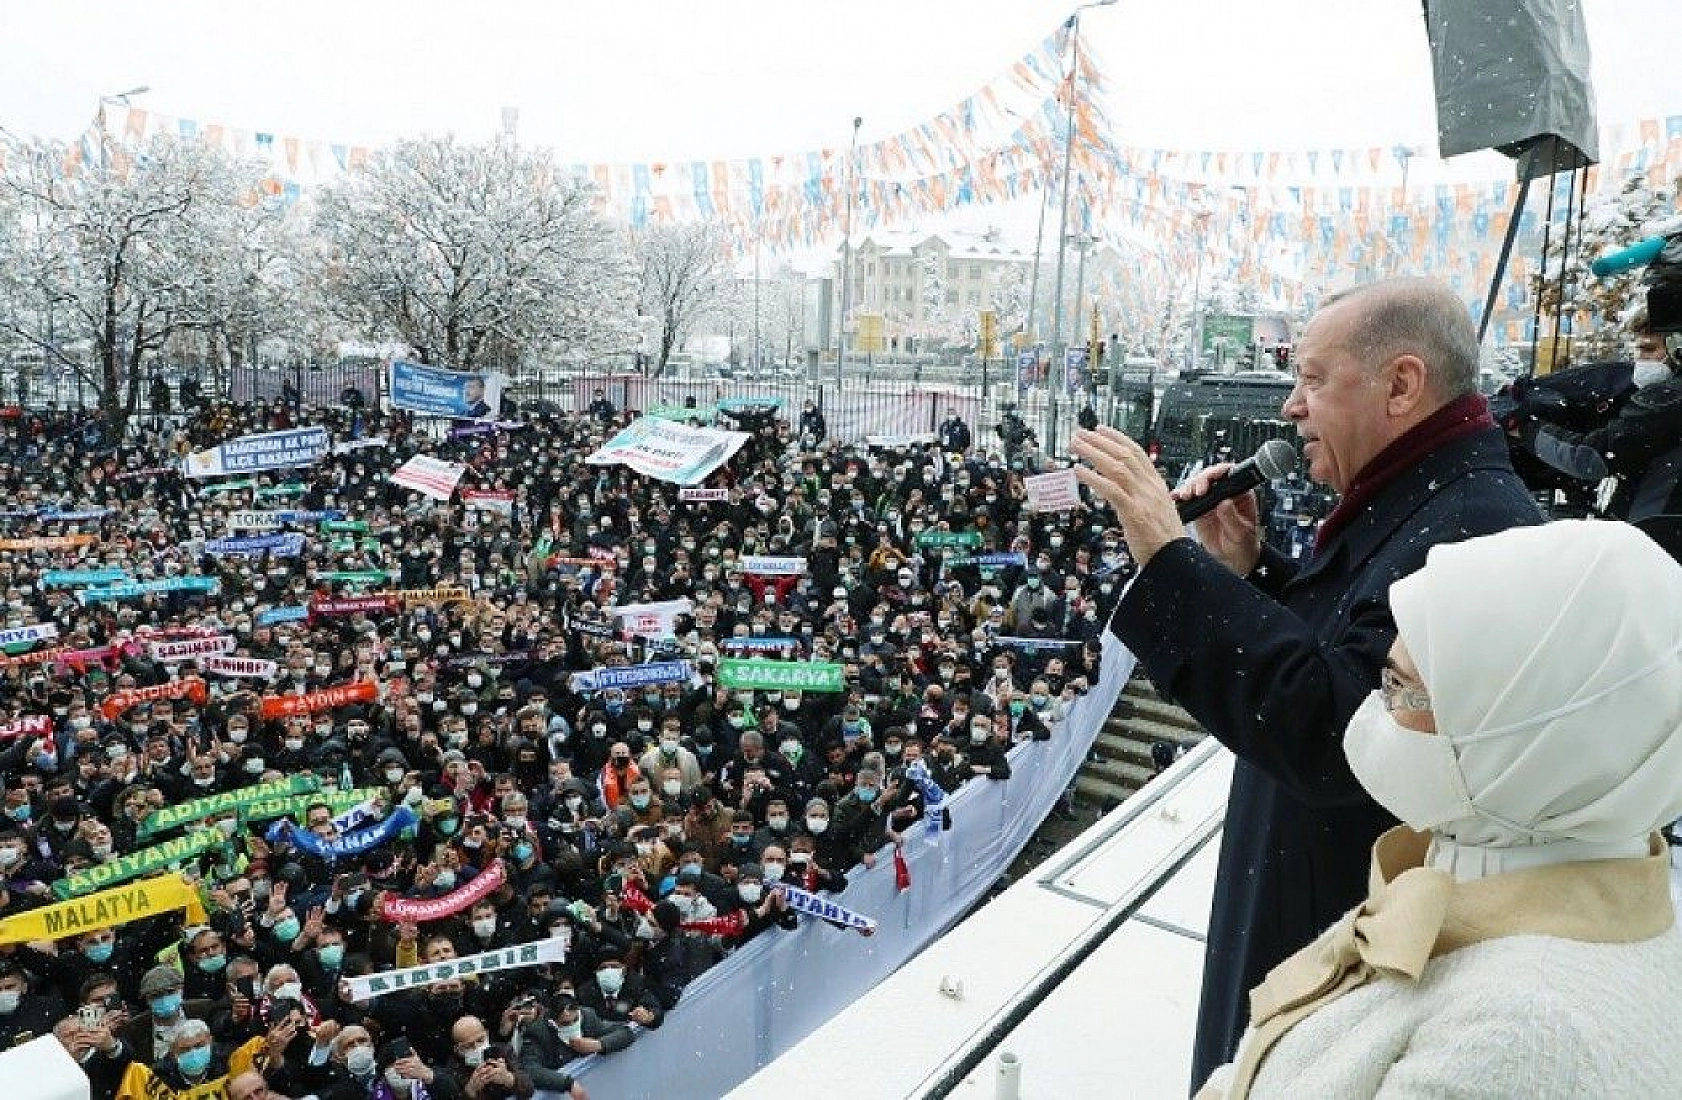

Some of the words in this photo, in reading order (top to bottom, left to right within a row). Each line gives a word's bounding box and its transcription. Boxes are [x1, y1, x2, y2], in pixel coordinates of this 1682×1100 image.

[735, 665, 829, 687] SAKARYA
[157, 780, 291, 827] ADIYAMAN
[68, 828, 224, 891] ADIYAMAN
[43, 889, 151, 934] MALATYA
